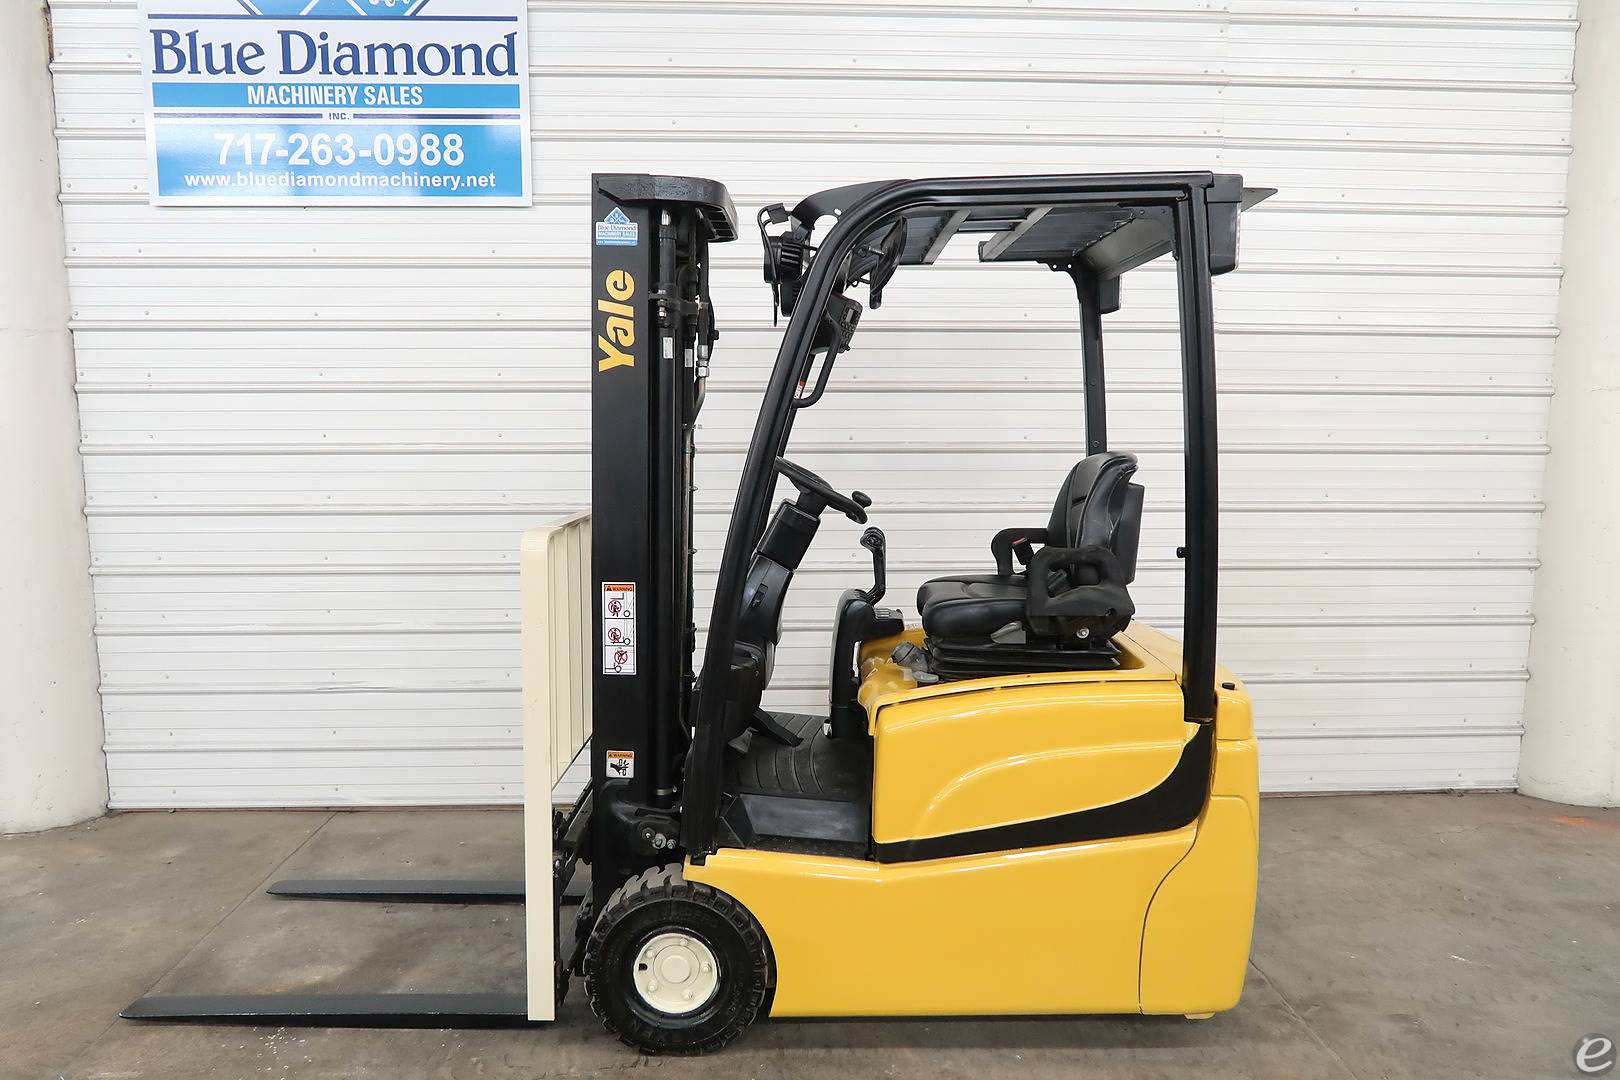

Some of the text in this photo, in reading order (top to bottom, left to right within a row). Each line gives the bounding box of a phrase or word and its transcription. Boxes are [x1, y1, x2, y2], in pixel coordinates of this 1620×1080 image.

[149, 28, 519, 77] Blue Diamond
[247, 85, 423, 106] MACHINERY SALES
[328, 112, 350, 121] INC.
[213, 133, 465, 167] 717-263-0988
[184, 171, 496, 191] www.bluediamondmachinery.net
[597, 269, 635, 372] Yale
